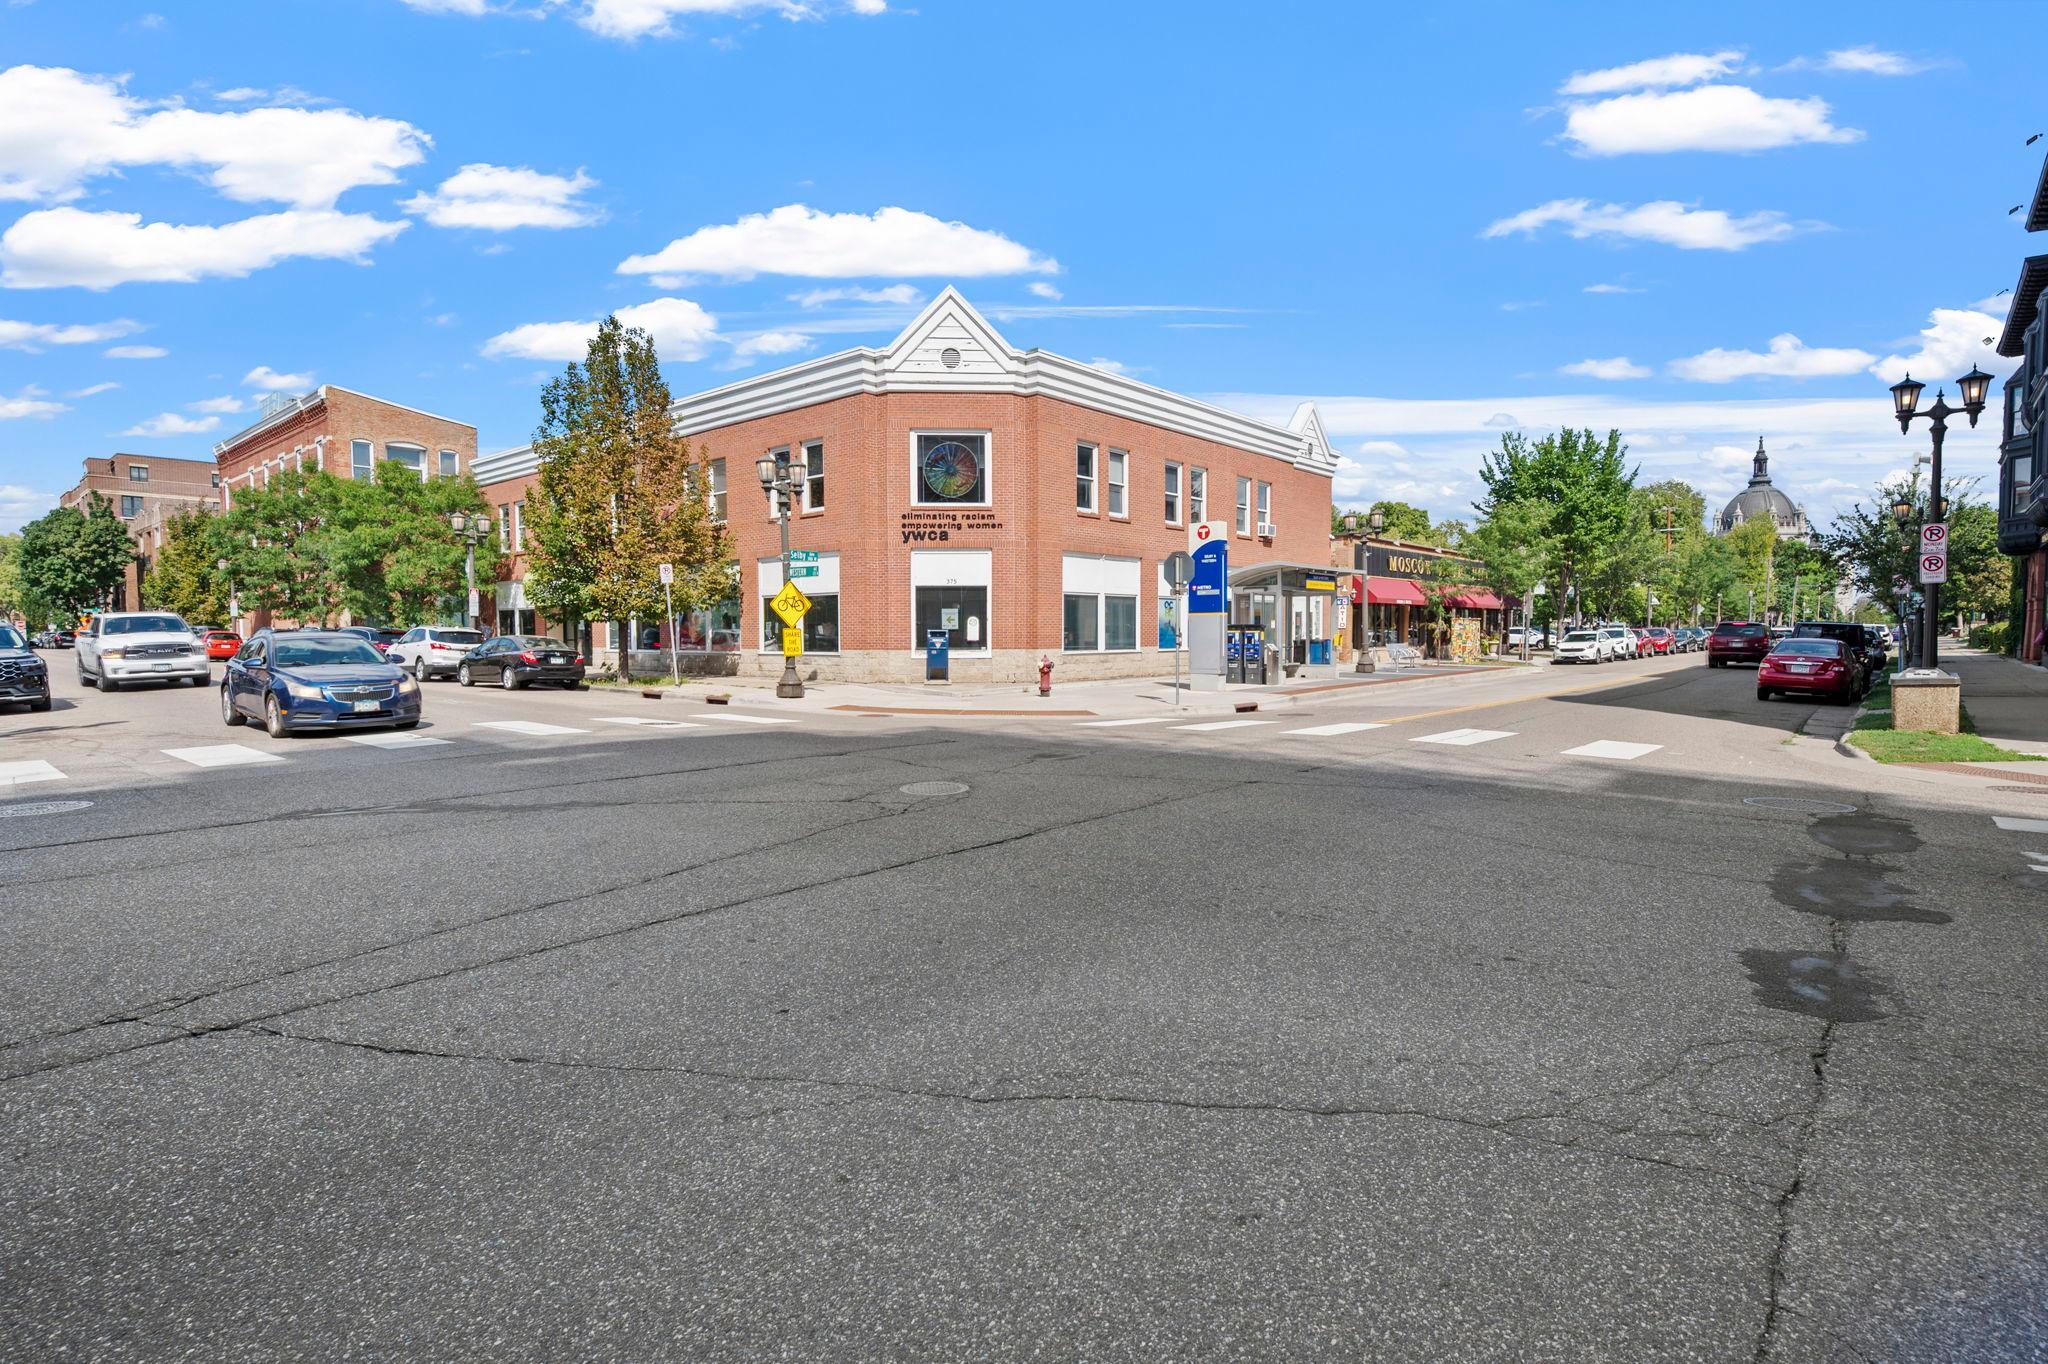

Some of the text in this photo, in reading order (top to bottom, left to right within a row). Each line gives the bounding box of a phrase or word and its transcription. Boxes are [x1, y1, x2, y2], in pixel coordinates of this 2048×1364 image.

[901, 512, 995, 521] eliminating racism
[901, 522, 962, 530] empowering
[901, 530, 949, 543] ywca
[790, 550, 806, 561] Selby
